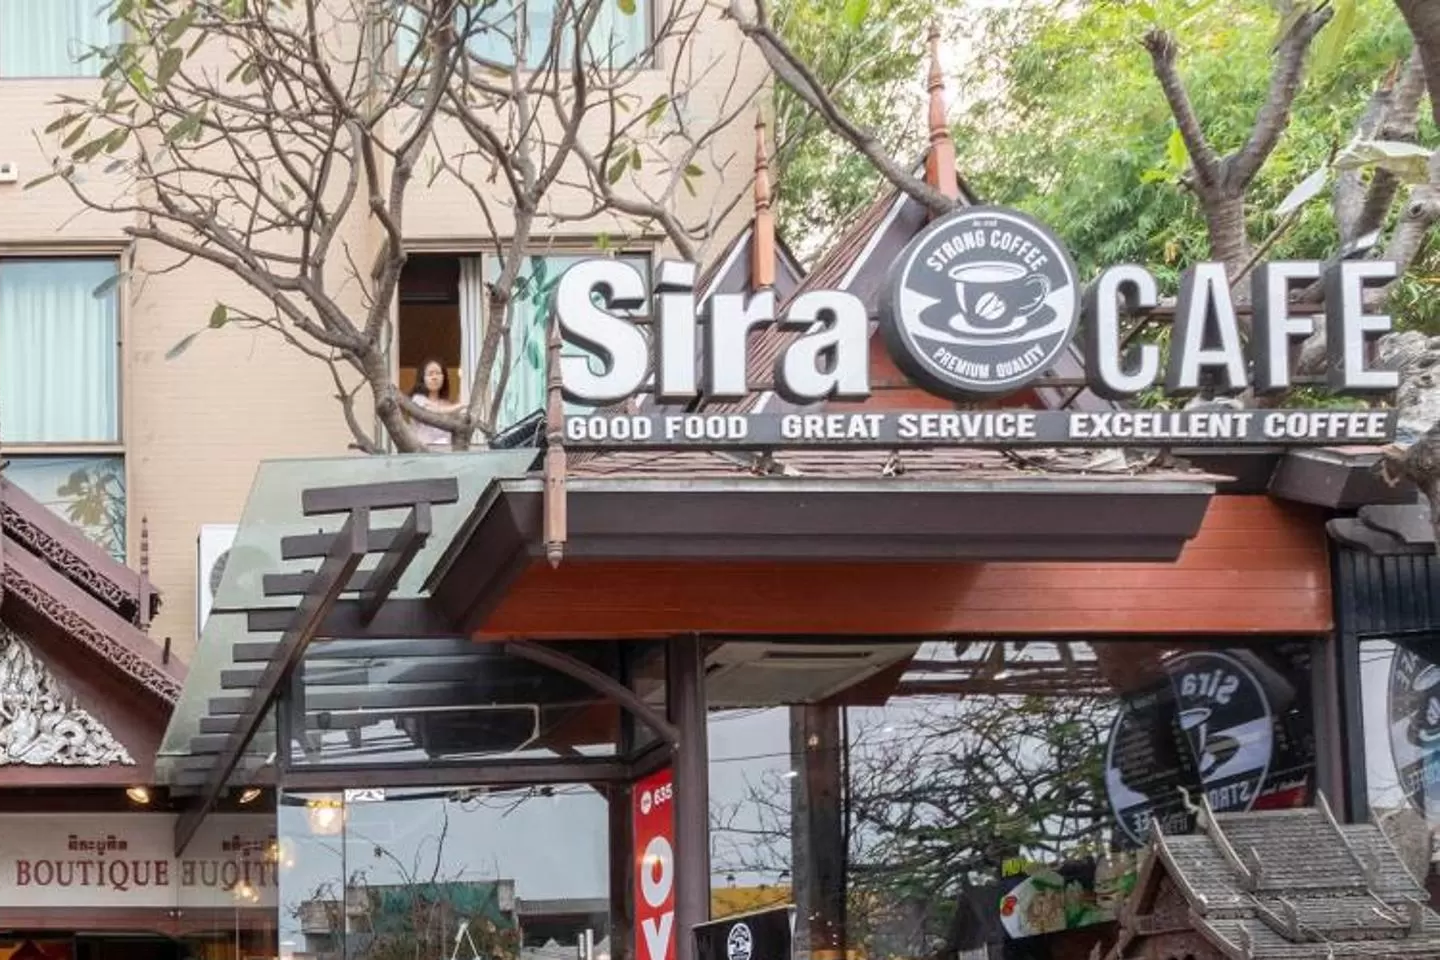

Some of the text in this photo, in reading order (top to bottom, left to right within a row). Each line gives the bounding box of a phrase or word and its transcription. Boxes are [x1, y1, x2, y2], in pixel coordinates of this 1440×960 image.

[926, 229, 1049, 273] STRONG COFFEE
[556, 258, 1401, 402] Sira CAFE
[932, 342, 1046, 378] PREMIUM QUALITY
[566, 411, 1389, 441] GOOD FOOD GREAT SERVICE EXCELLENT COFFEE
[16, 859, 169, 891] BOUTIQUE
